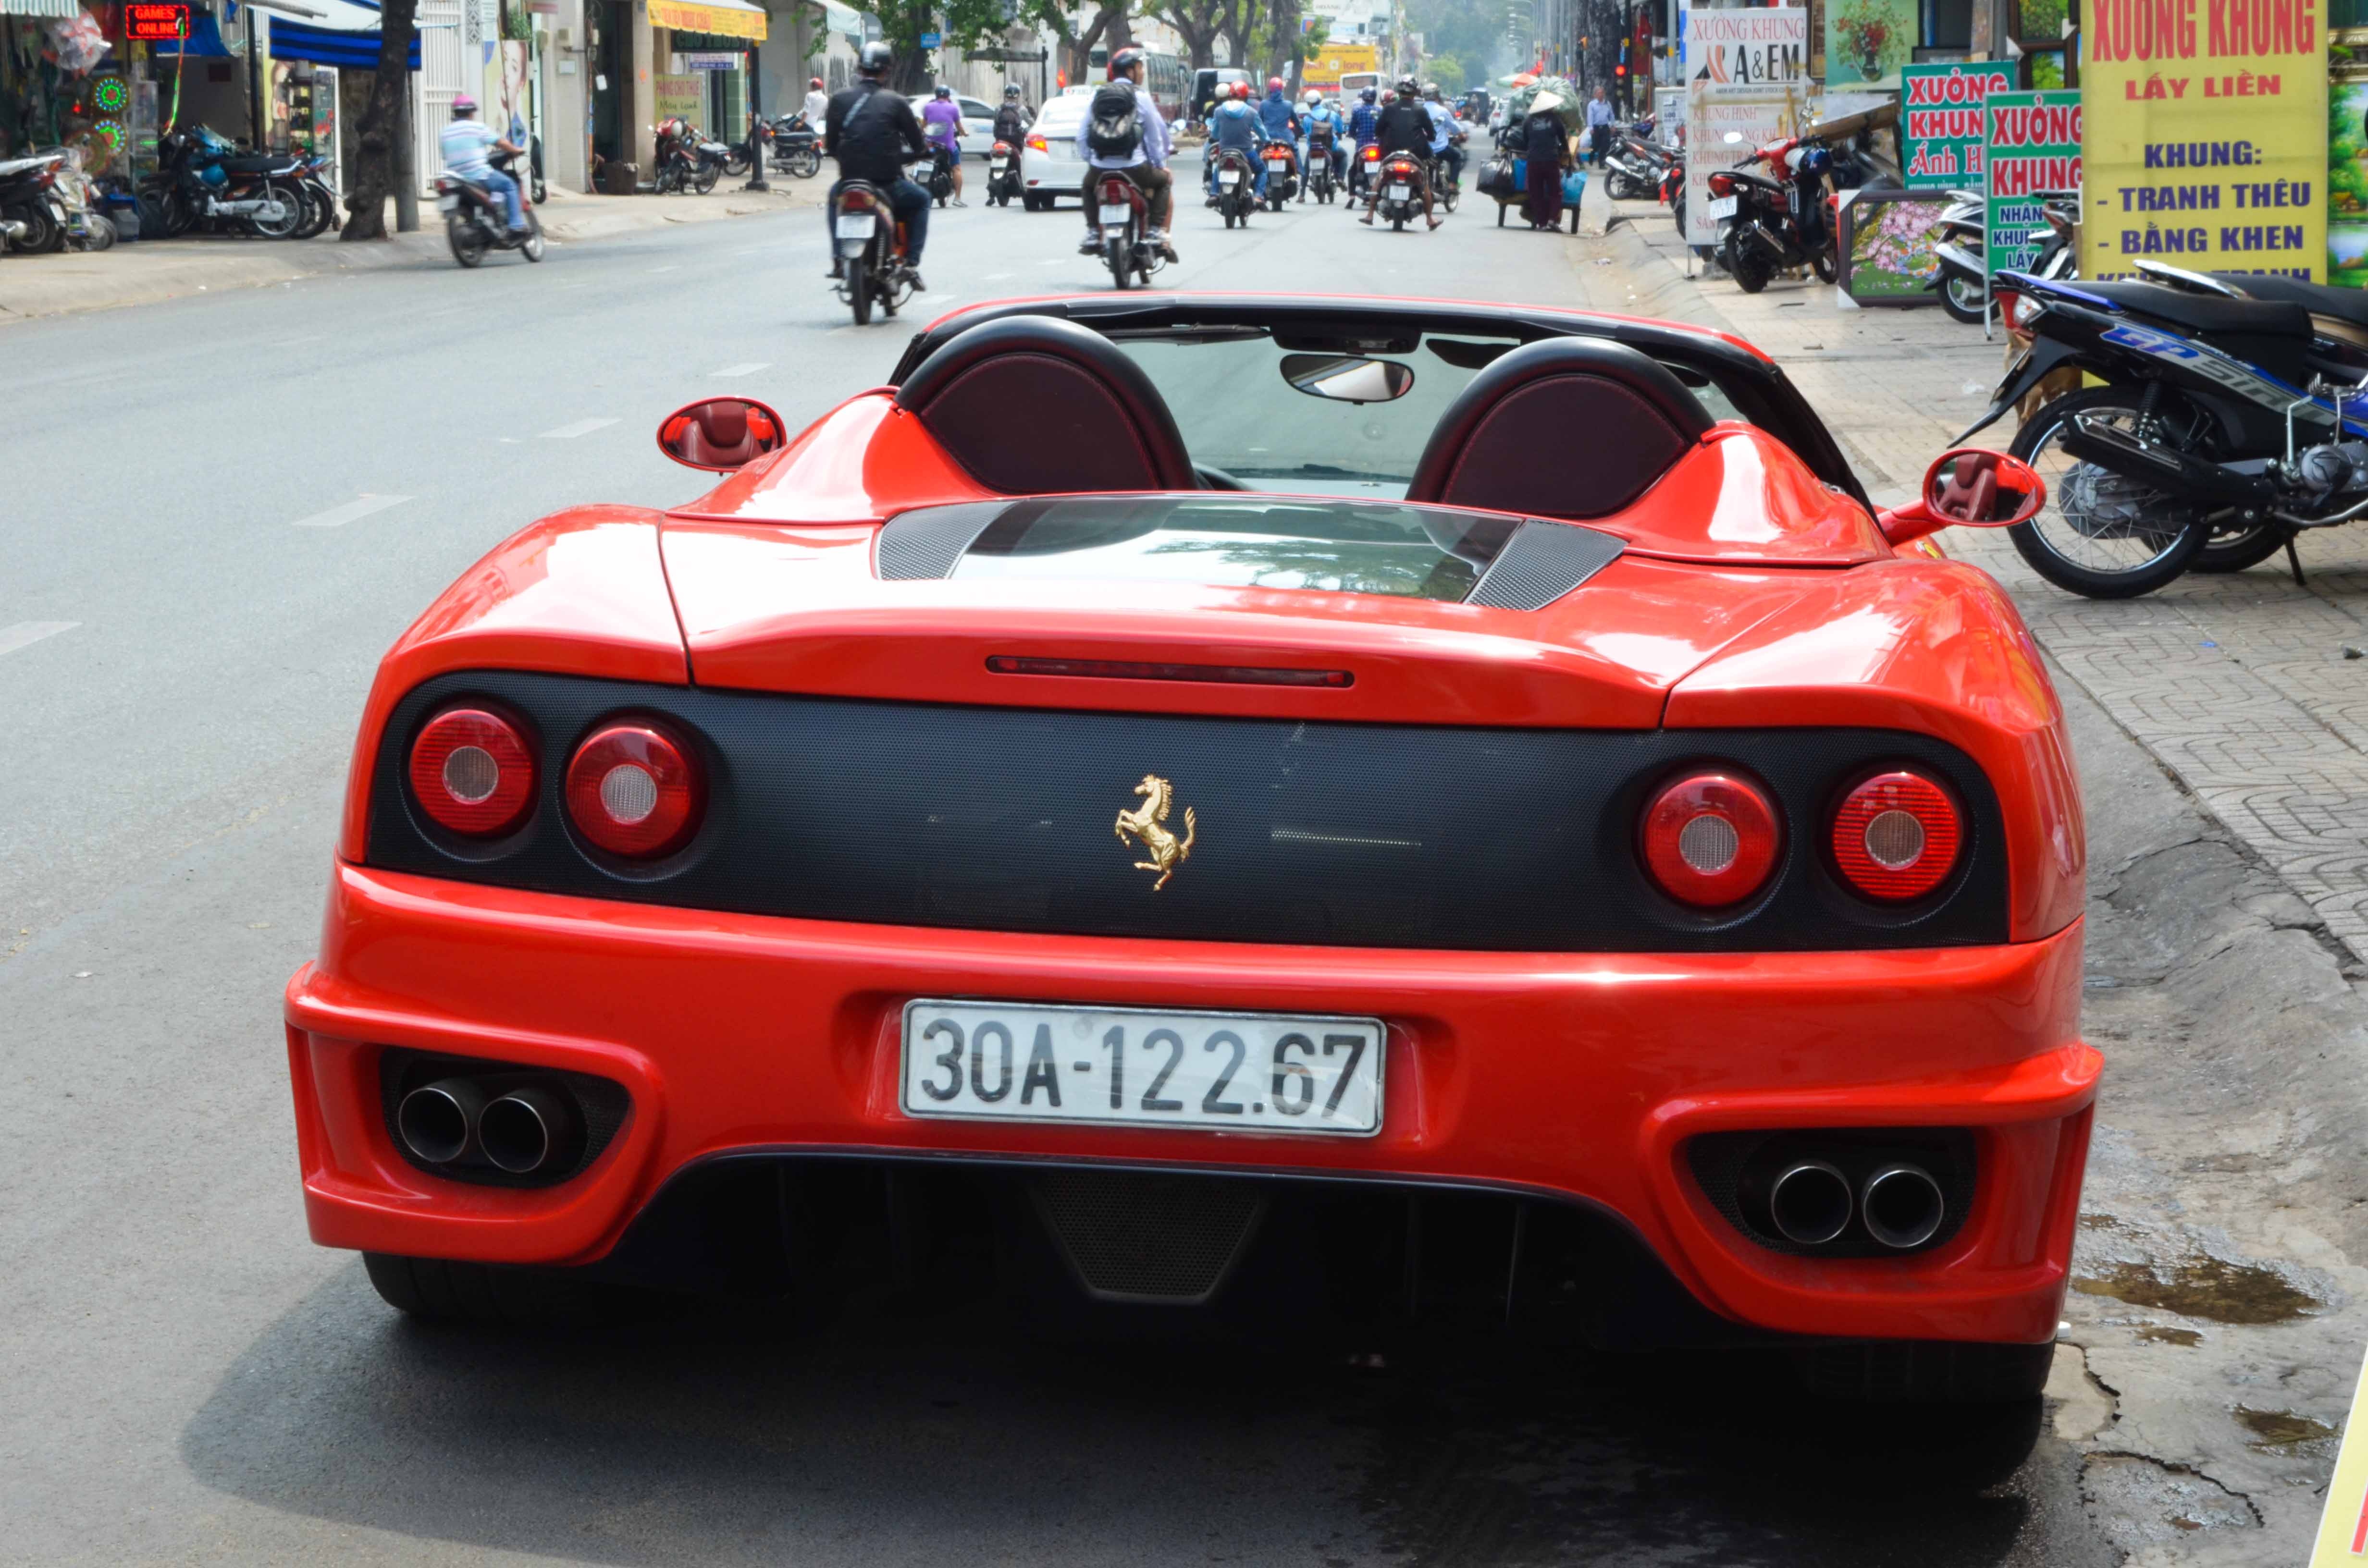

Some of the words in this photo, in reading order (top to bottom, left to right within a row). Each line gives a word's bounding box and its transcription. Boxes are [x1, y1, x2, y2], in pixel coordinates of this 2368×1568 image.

[135, 8, 176, 19] GAMES
[136, 23, 178, 34] ONLINE
[1752, 18, 1807, 39] KHUNG
[2208, 0, 2315, 57] KHUNG
[1908, 69, 2008, 103] XƯỞNG
[2125, 72, 2190, 100] LẤY
[2204, 69, 2281, 97] LIỀN
[1693, 107, 1729, 120] KHUNG
[1909, 110, 1984, 138] KHUN
[1992, 95, 2082, 145] XƯỞNG
[1909, 142, 1958, 175] Ánh
[2145, 141, 2262, 168] KHUNG:
[1993, 157, 2082, 196] KHUNG
[2118, 184, 2220, 211] TRANH
[2232, 178, 2310, 208] THÊU
[2000, 203, 2043, 224] NHẬN
[2121, 221, 2208, 254] BẰNG
[2220, 225, 2303, 251] KHEN
[921, 1017, 1367, 1118] 30A-122.67
